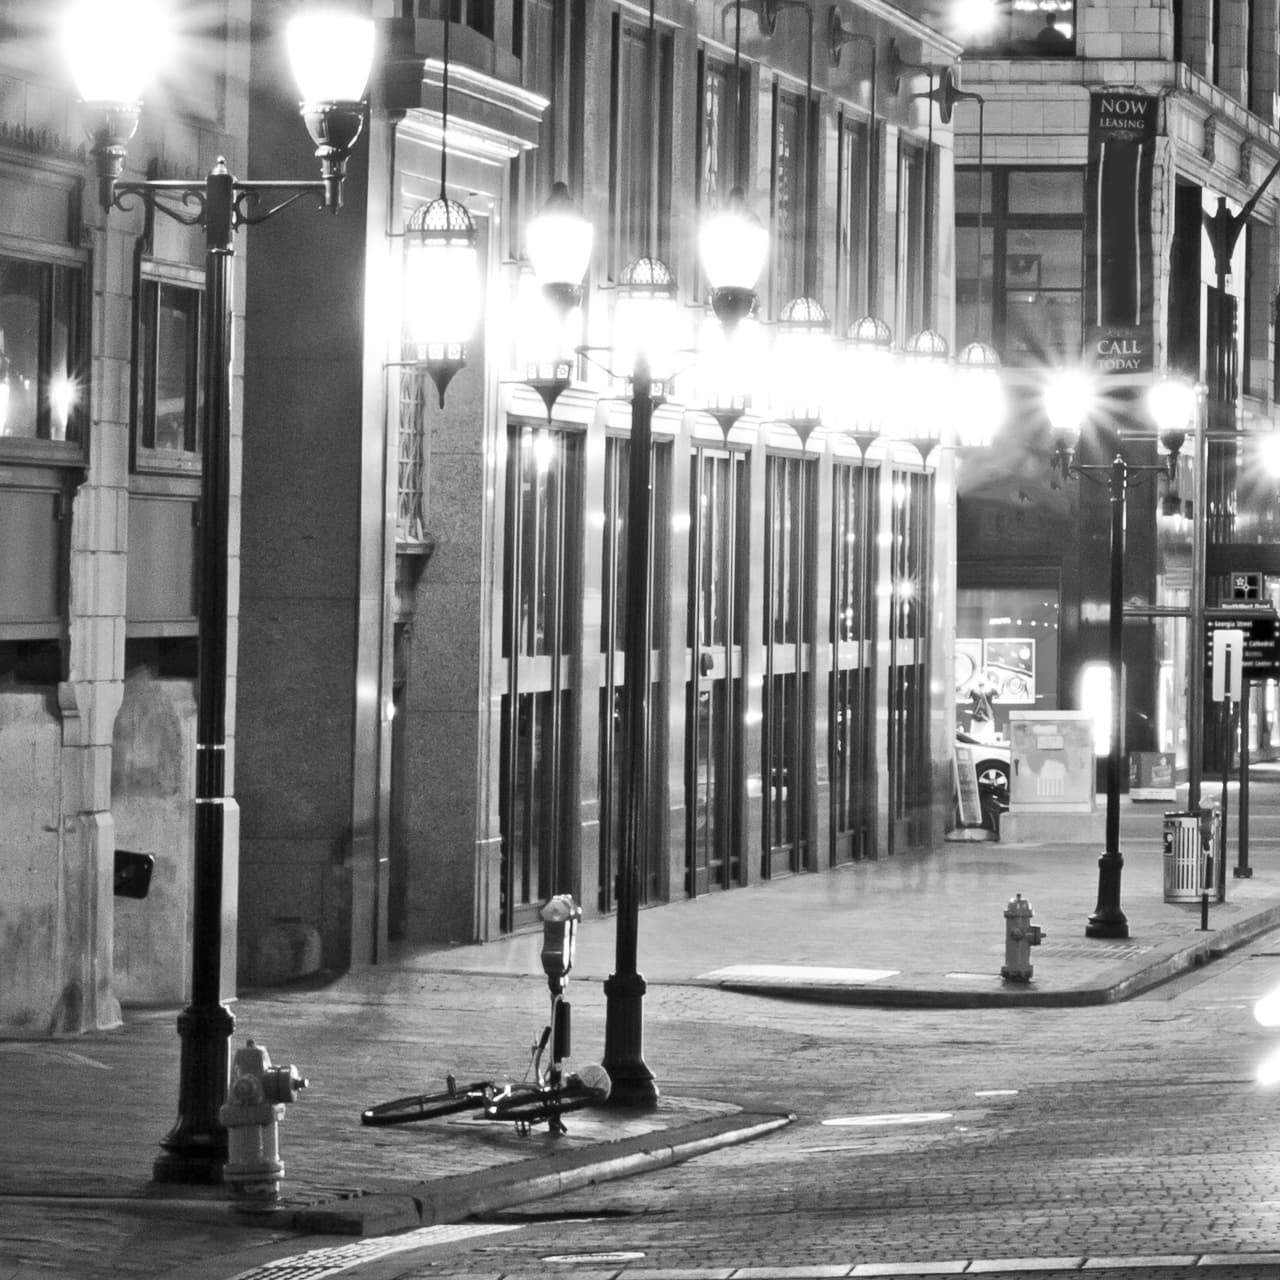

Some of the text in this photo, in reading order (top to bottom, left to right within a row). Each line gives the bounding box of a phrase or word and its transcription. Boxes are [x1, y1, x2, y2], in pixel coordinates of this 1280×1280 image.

[1101, 99, 1148, 114] NOW
[1099, 117, 1145, 129] LEASING
[1097, 340, 1142, 355] CALL
[1097, 359, 1140, 370] TODAY
